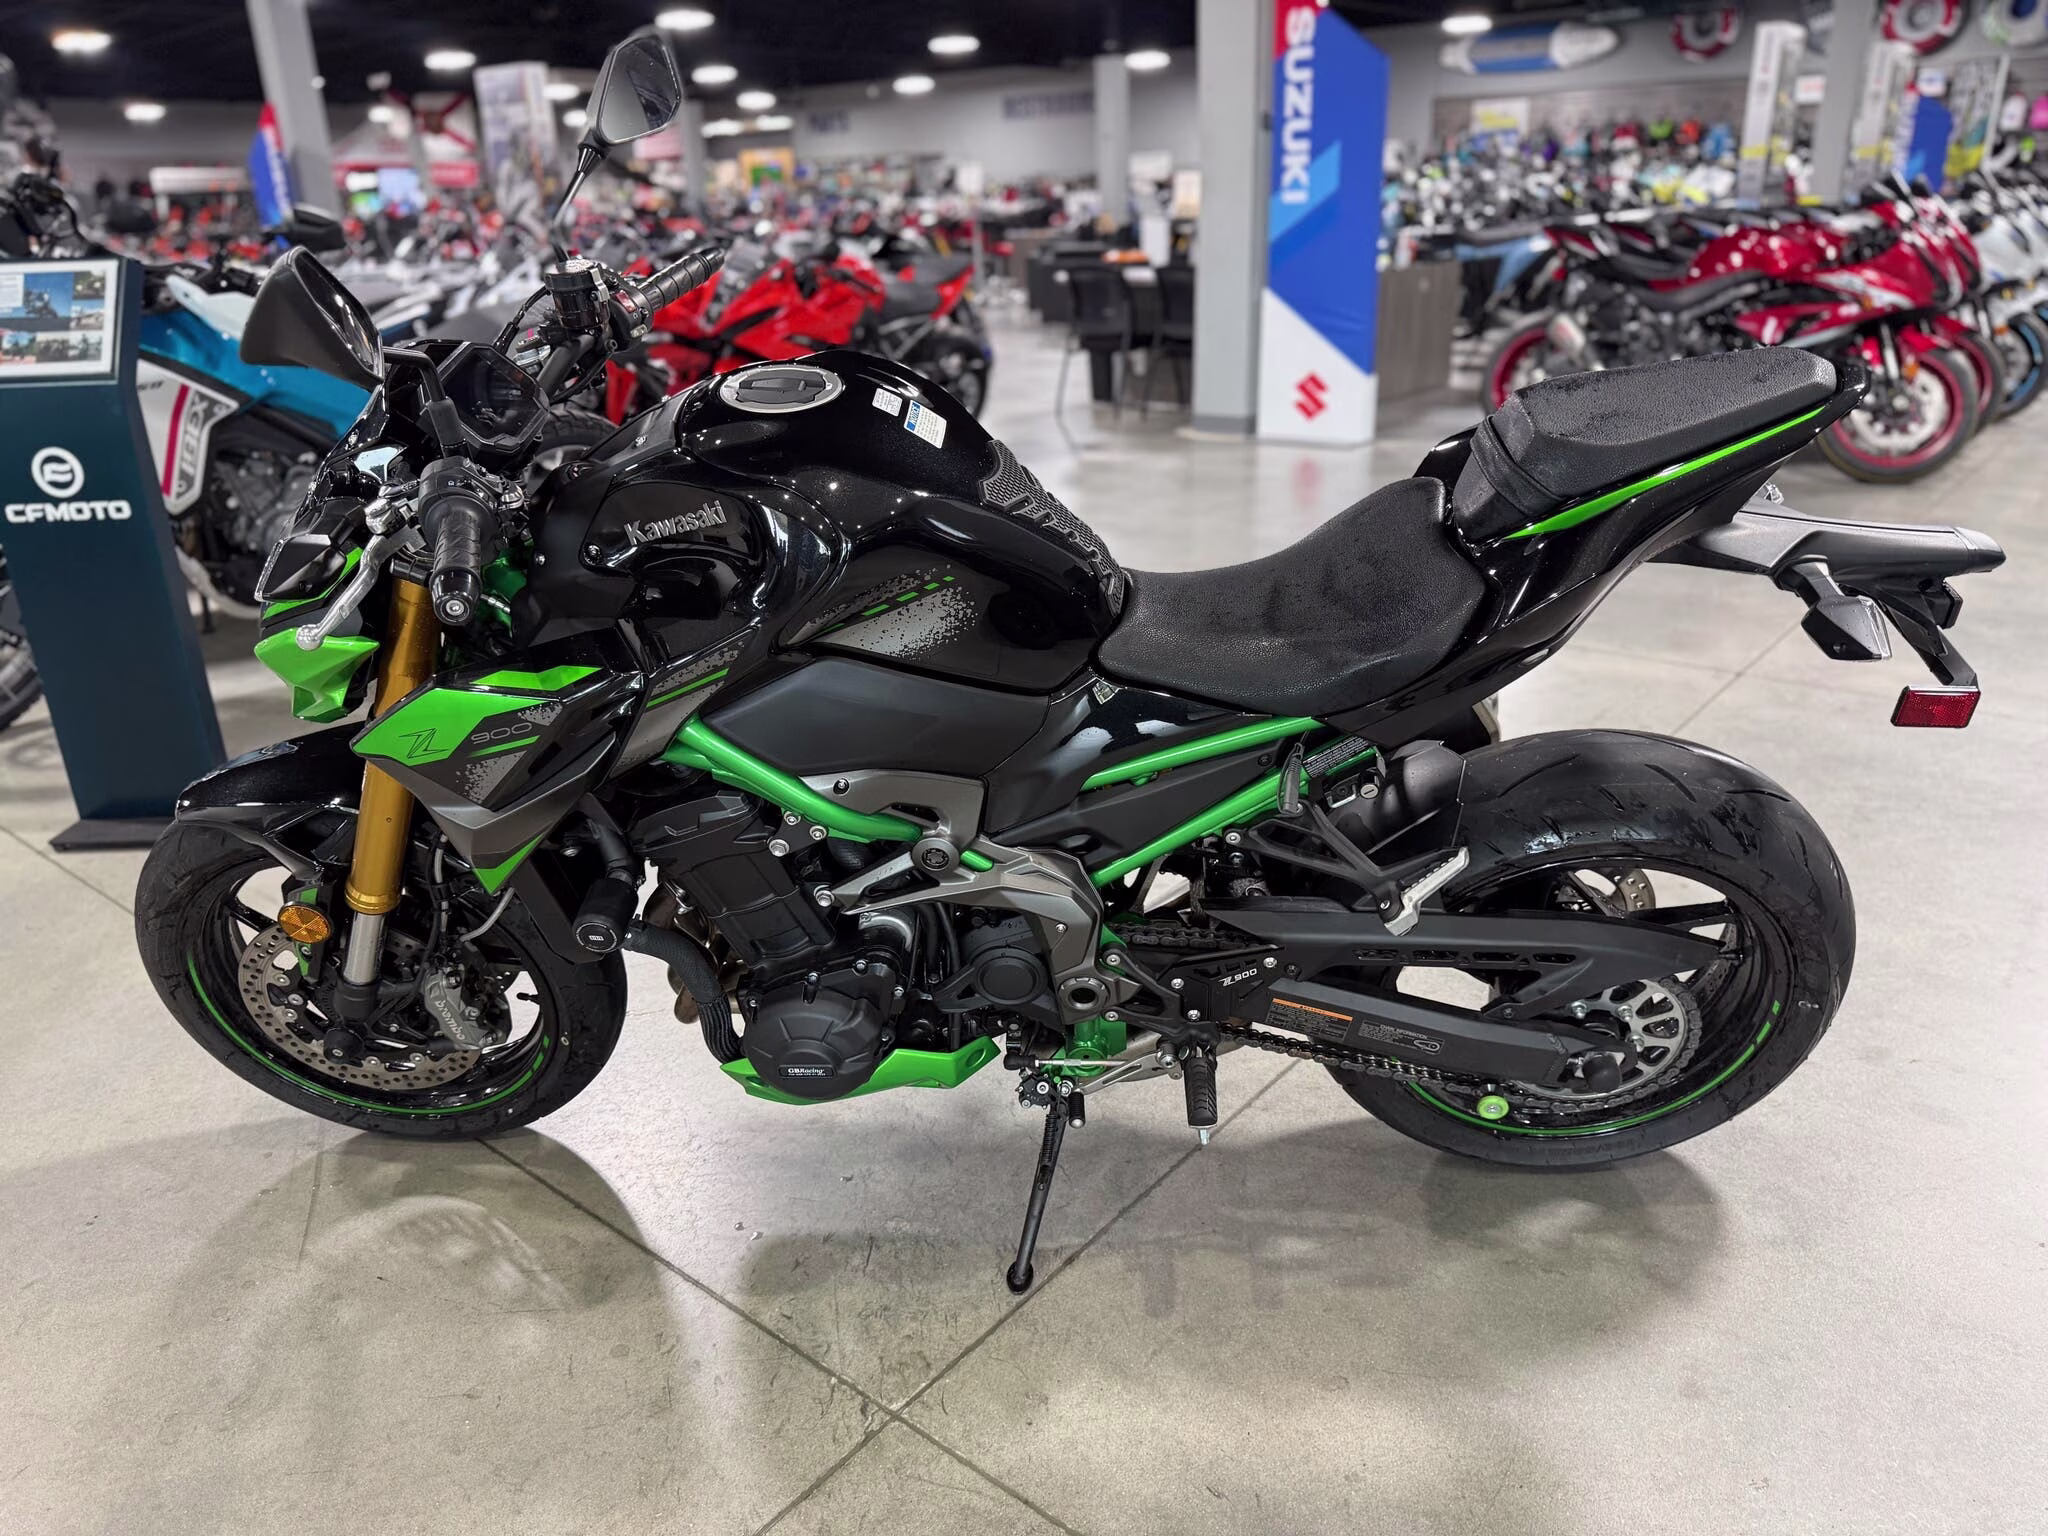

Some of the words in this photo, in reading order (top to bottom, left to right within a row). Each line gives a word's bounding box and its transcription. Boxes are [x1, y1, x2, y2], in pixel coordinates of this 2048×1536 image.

[1281, 6, 1317, 204] SUZUKI
[4, 499, 132, 523] CFMOTO
[624, 500, 727, 546] Kawasaki
[471, 722, 533, 745] 900
[434, 999, 466, 1040] brembo
